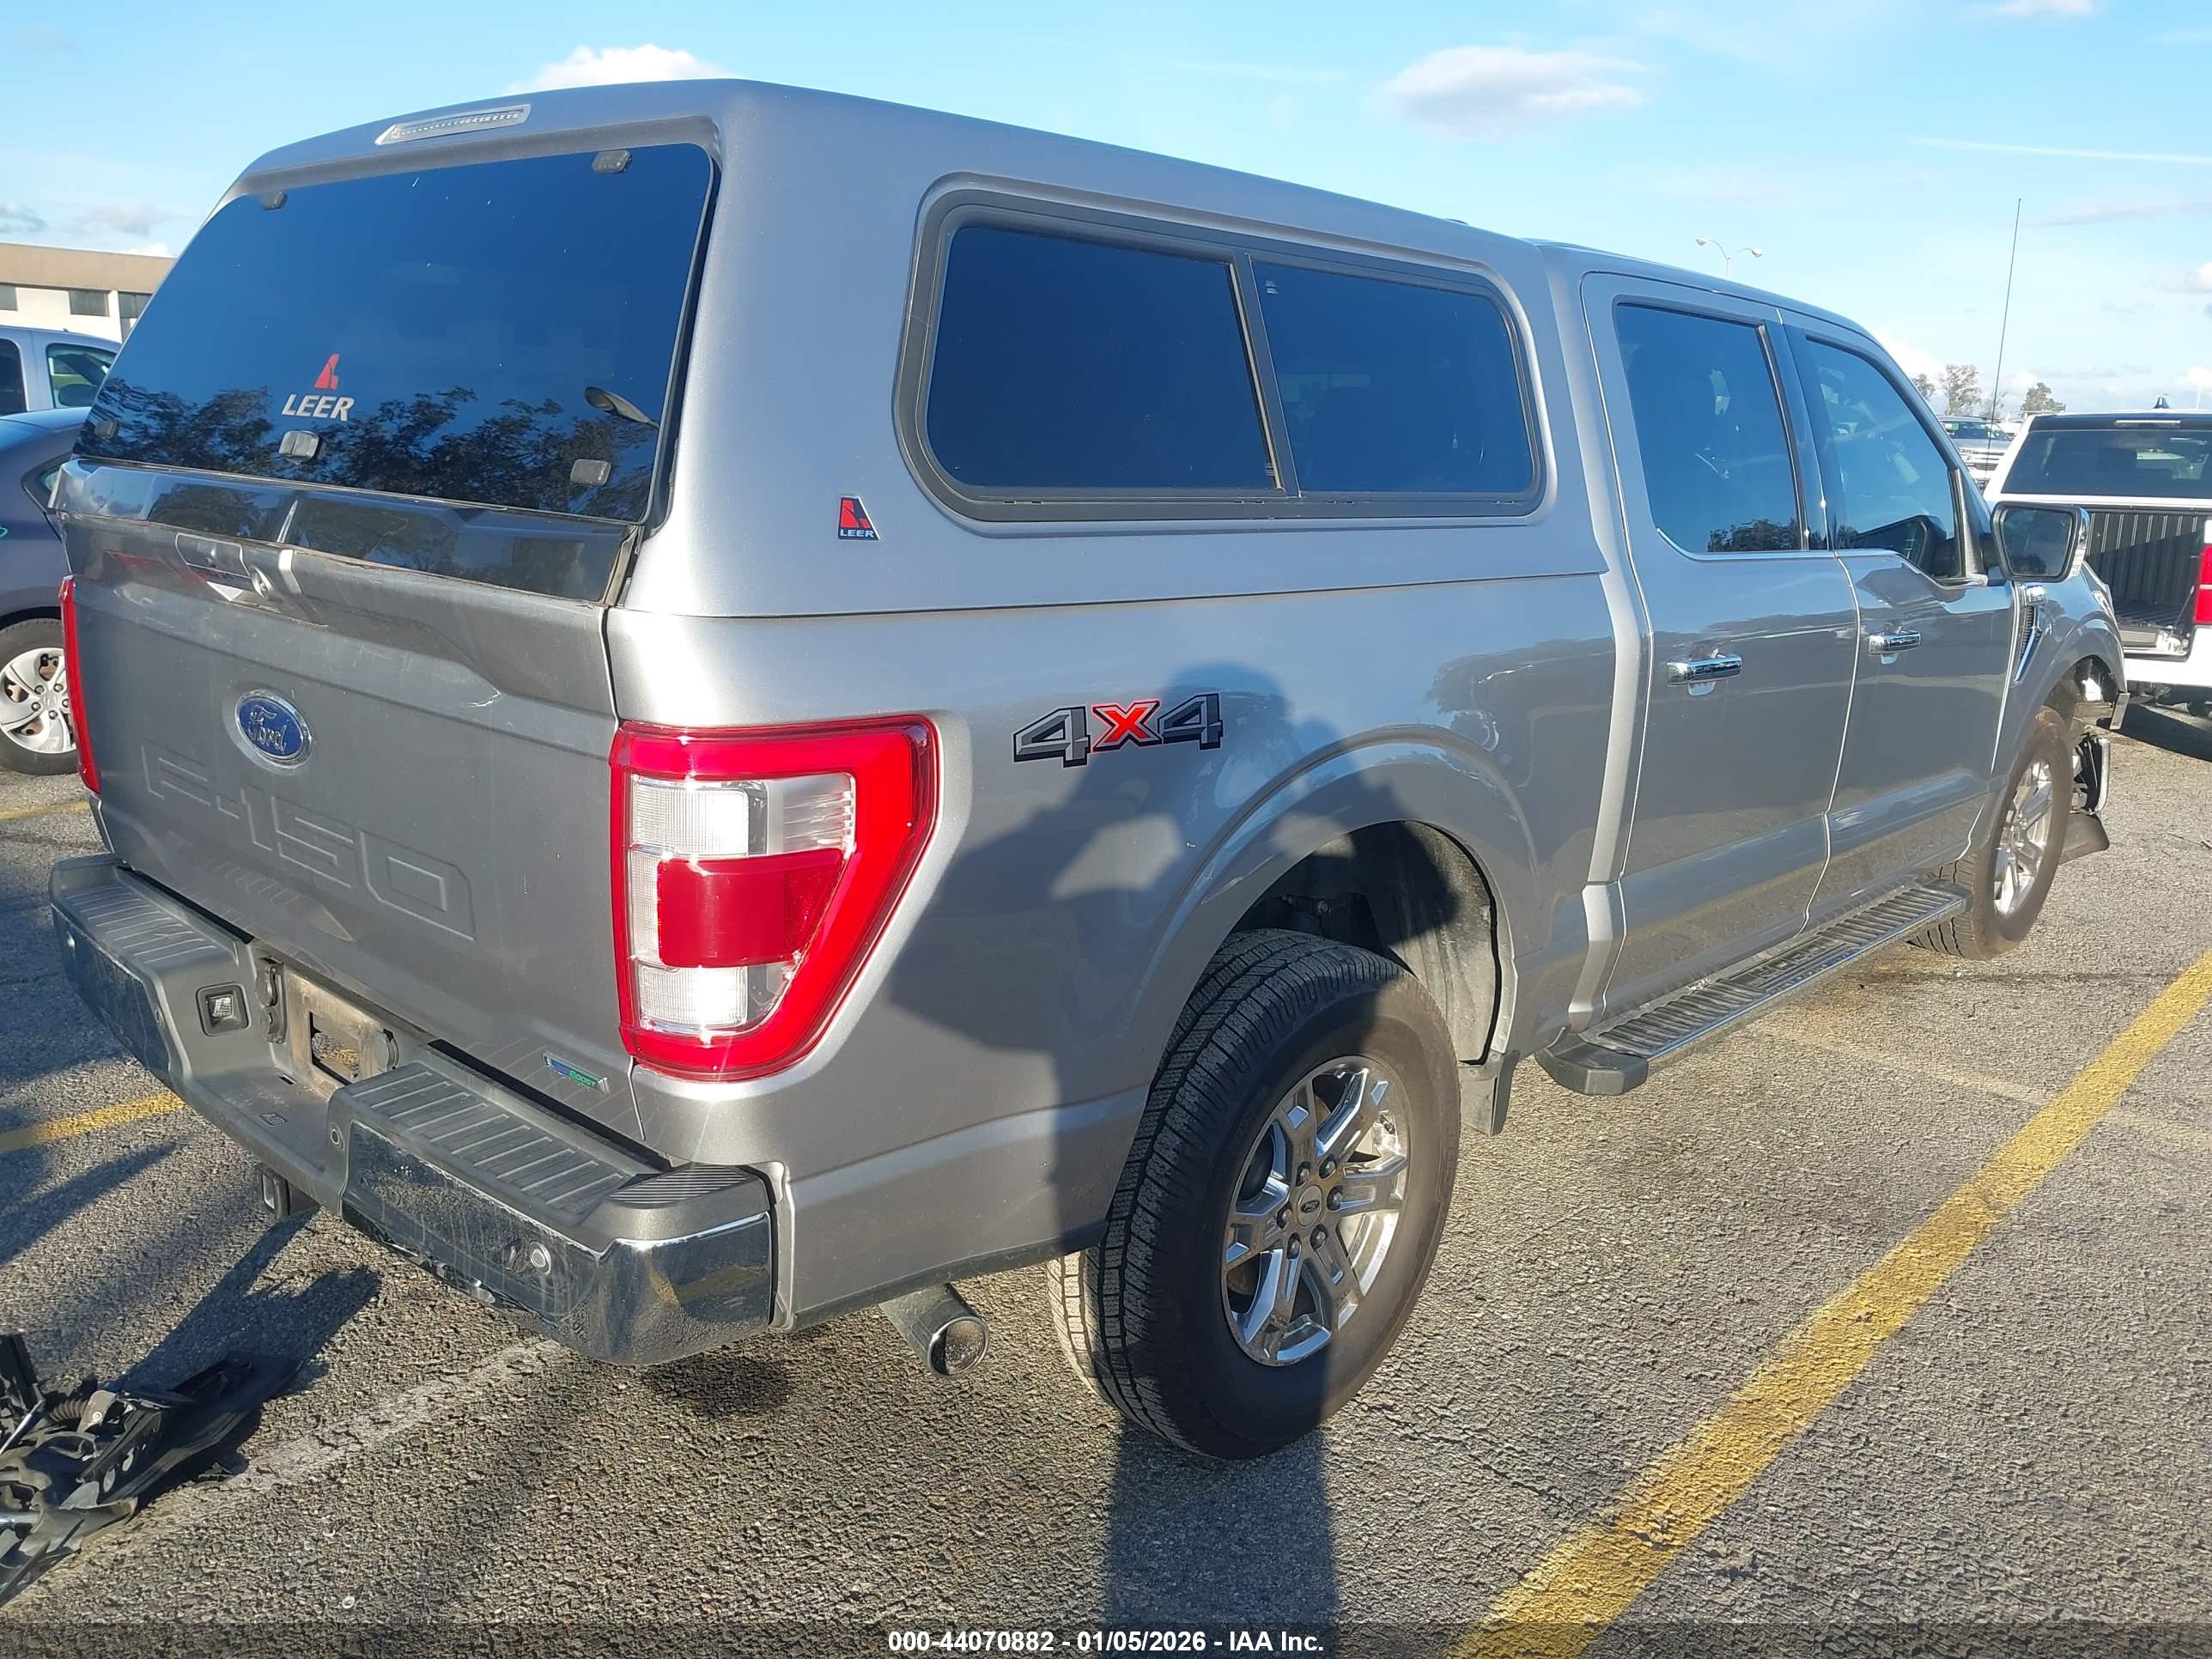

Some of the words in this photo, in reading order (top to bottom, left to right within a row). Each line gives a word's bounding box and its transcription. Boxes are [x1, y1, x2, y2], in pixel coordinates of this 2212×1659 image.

[281, 393, 356, 422] LEER
[840, 528, 875, 538] LEER
[248, 704, 288, 752] Ford
[140, 738, 477, 942] F-150
